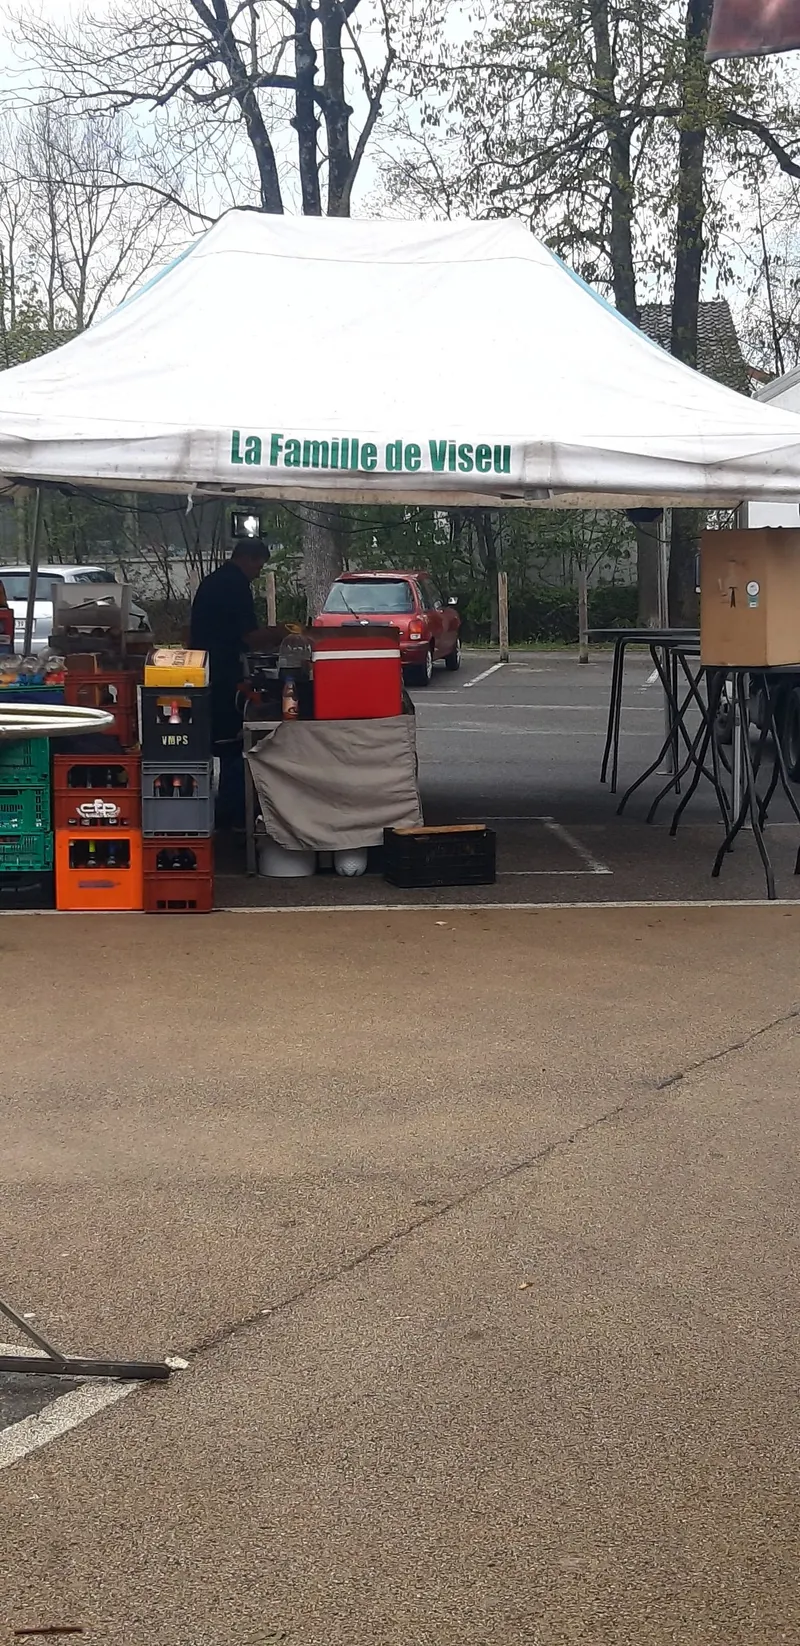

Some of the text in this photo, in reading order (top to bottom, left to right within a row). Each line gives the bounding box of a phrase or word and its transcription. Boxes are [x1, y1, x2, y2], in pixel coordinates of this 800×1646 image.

[230, 430, 512, 474] La Famille de Viseu
